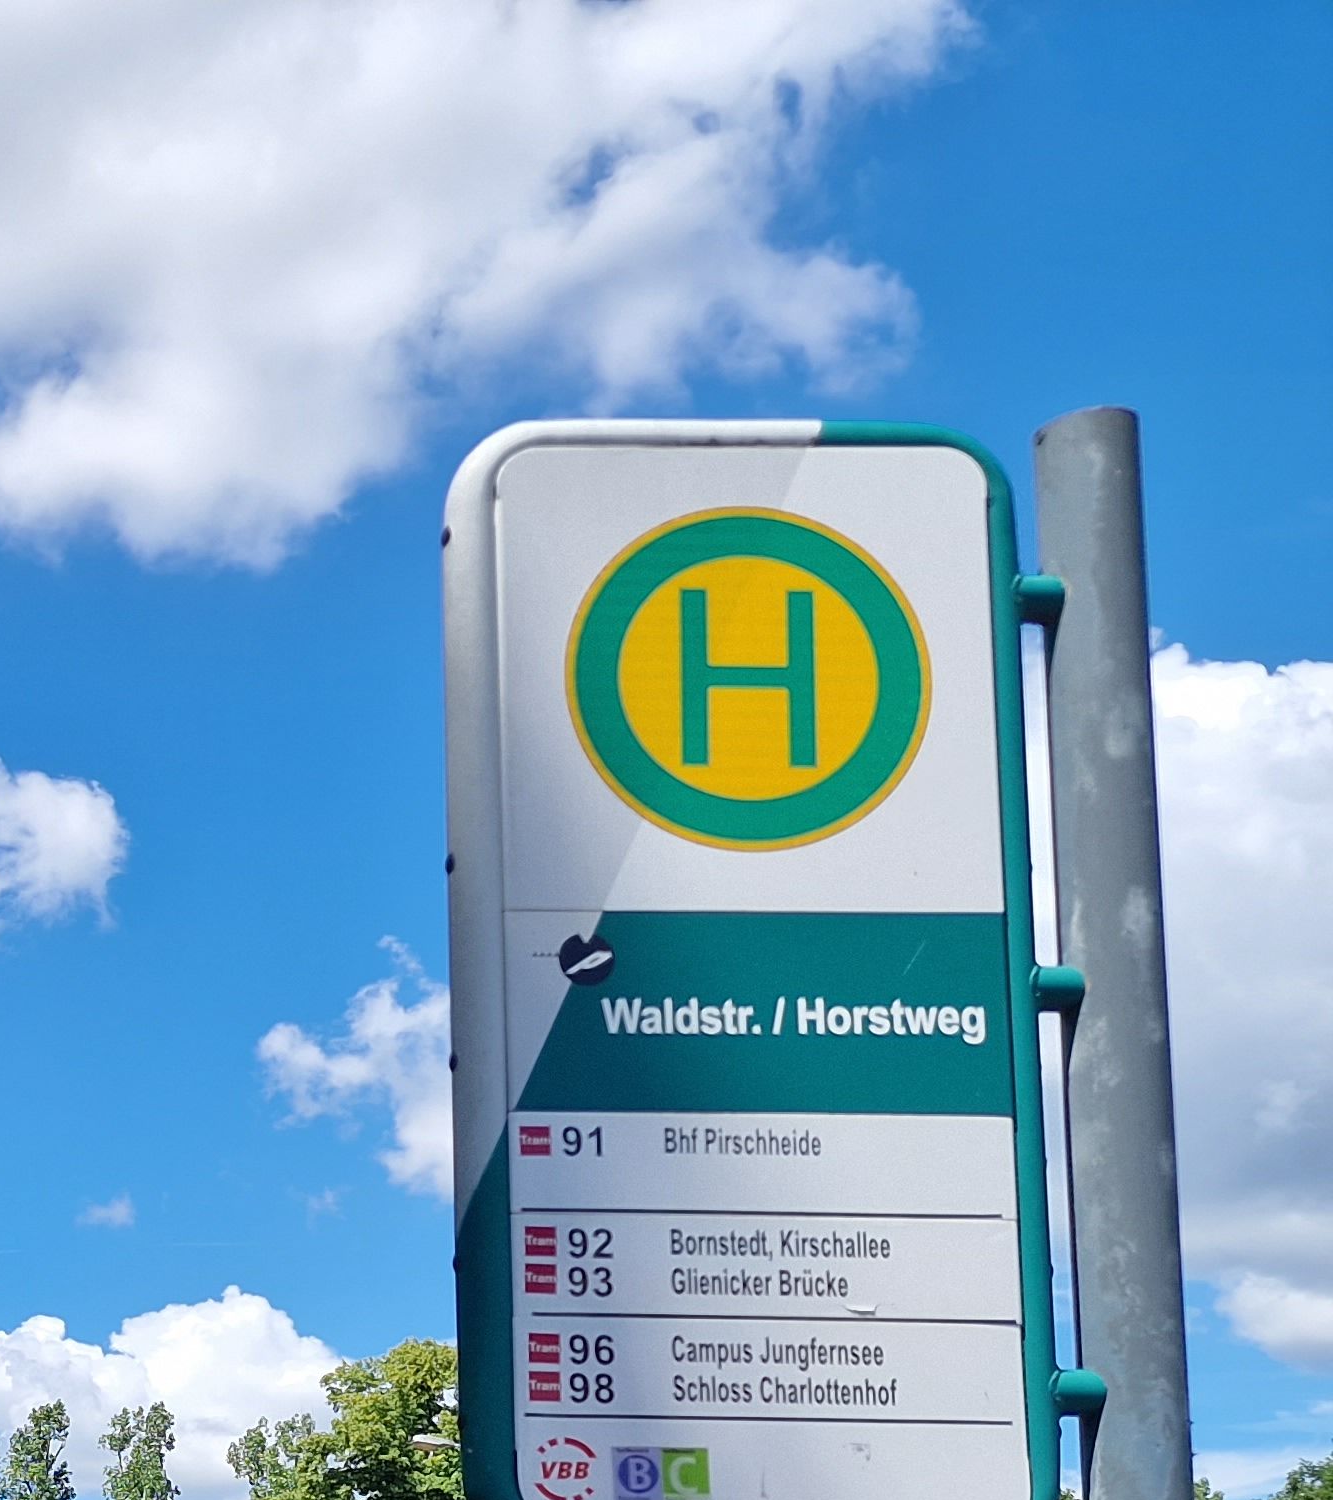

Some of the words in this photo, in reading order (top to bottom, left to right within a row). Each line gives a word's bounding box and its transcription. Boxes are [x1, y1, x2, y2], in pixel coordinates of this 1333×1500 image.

[679, 587, 817, 769] H
[600, 996, 762, 1036] Waldstr.
[771, 996, 786, 1036] /
[796, 997, 987, 1046] Horstweg
[562, 1126, 603, 1157] 91
[664, 1127, 698, 1154] Bhf
[704, 1127, 822, 1157] Pirschheide
[568, 1228, 614, 1259] 92
[669, 1228, 774, 1262] Bornstedt,
[779, 1229, 892, 1259] Kirschallee
[525, 1271, 557, 1284] Tram
[568, 1266, 613, 1298] 93
[671, 1267, 773, 1297] Glienicker
[778, 1269, 849, 1298] Brücke
[529, 1341, 562, 1354] Tram
[569, 1334, 615, 1366] 96
[671, 1334, 754, 1370] Campus
[759, 1335, 885, 1372] Jungfernsee
[529, 1379, 562, 1392] Tram
[569, 1372, 615, 1404] 98
[672, 1374, 754, 1404] Schloss
[759, 1375, 898, 1407] Charlottenhof
[539, 1460, 591, 1481] VBB
[627, 1457, 653, 1491] B
[669, 1455, 699, 1497] C
